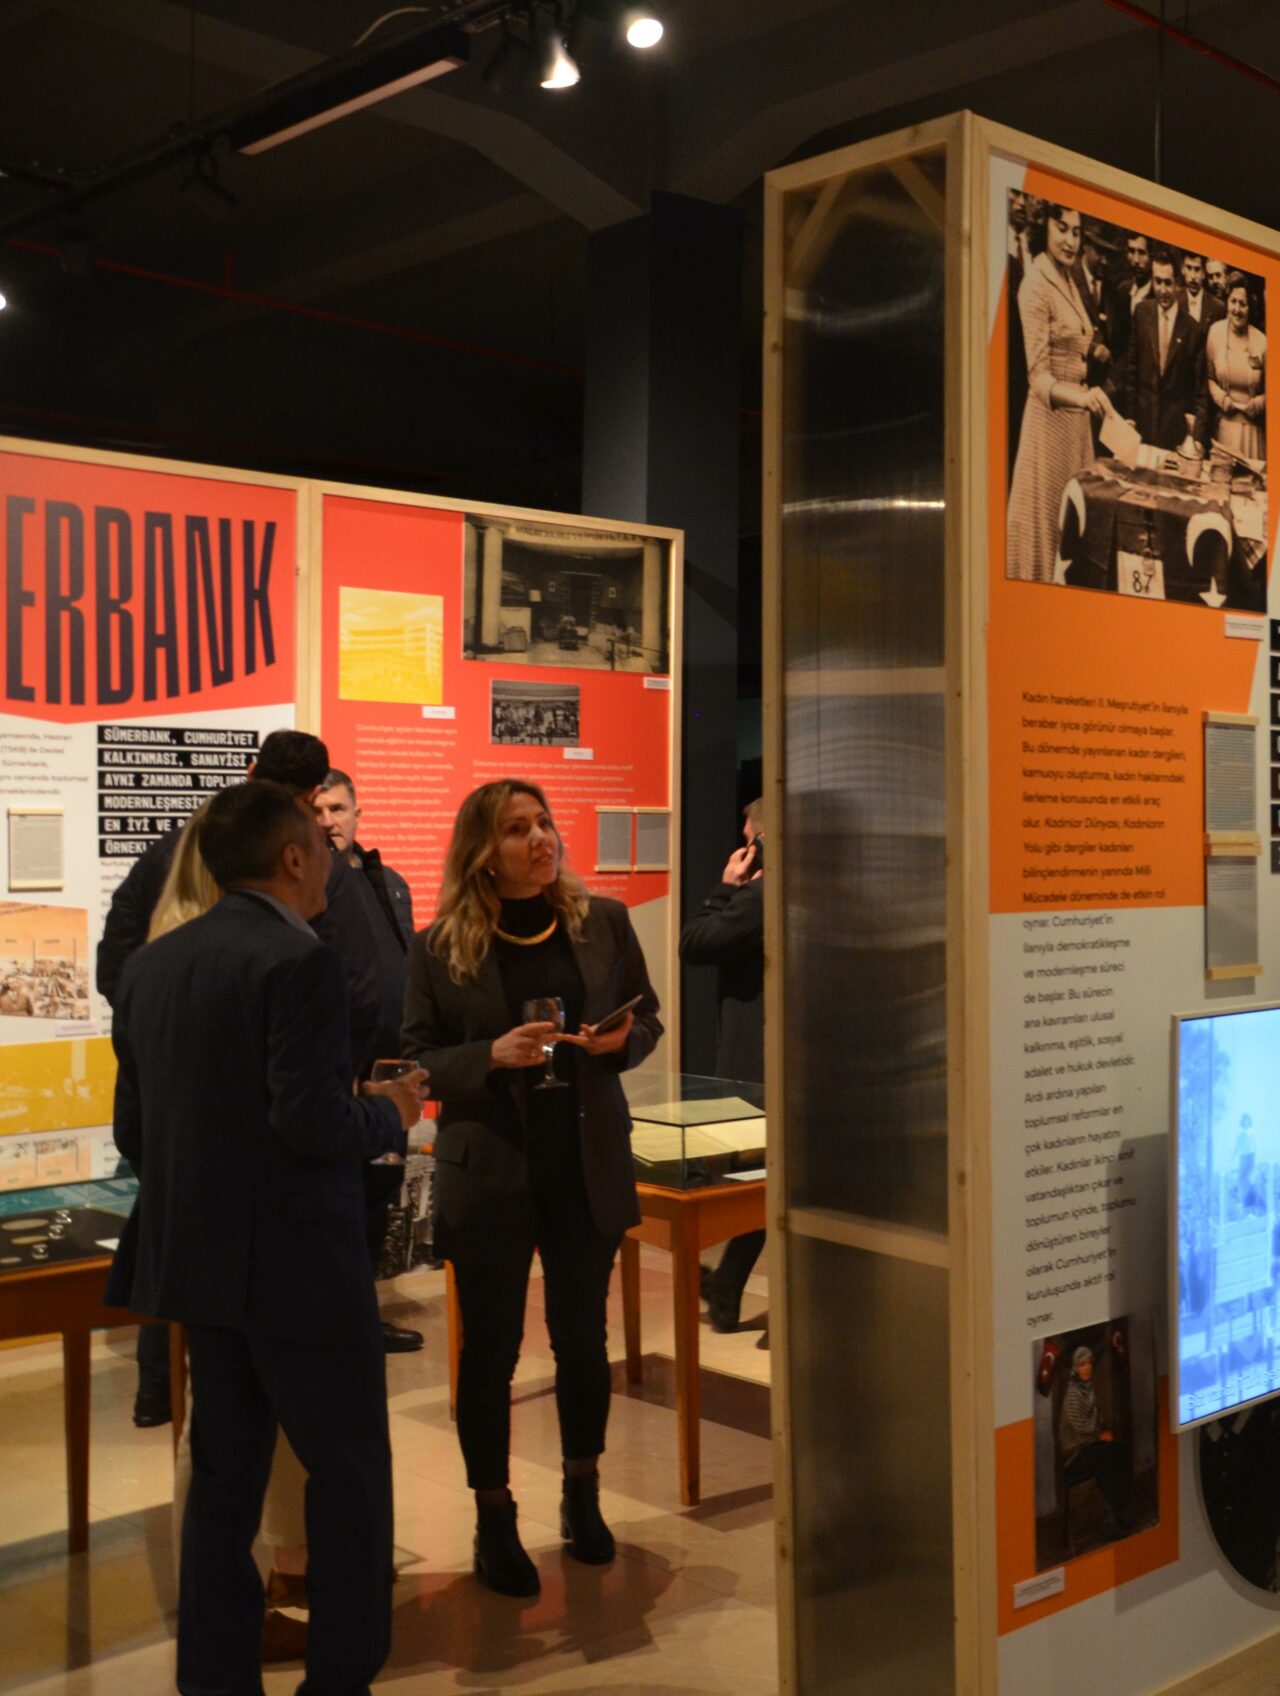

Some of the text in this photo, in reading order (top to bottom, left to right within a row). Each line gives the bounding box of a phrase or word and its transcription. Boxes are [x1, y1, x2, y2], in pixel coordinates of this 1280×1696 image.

[6, 495, 276, 705] ERBANK
[1022, 692, 1048, 702] Kadın
[1022, 717, 1057, 728] beraber
[1060, 719, 1080, 732] iyice
[1083, 720, 1115, 733] görünür
[1119, 724, 1147, 737] olmaya
[104, 728, 254, 745] SÜMERBANK, CUMHURİYET
[1022, 742, 1034, 752] Bu
[1038, 742, 1079, 754] dönemde
[1129, 747, 1150, 758] kadın
[104, 753, 184, 767] KALKINMASI,
[191, 753, 247, 767] SANAYİSİ
[104, 774, 136, 786] AYNI
[142, 775, 193, 788] ZAMANDA
[1023, 770, 1063, 780] kamuoyu
[1067, 769, 1111, 782] oluşturma,
[1114, 770, 1135, 780] kadın
[1023, 793, 1058, 803] ilerleme
[1061, 793, 1107, 804] konusunda
[1111, 796, 1120, 804] en
[105, 819, 120, 831] EN
[127, 817, 150, 831] İYİ
[156, 819, 171, 831] VE
[1045, 818, 1082, 828] Kadınlar
[1045, 843, 1061, 855] gibi
[1064, 843, 1097, 855] dergiler
[1101, 867, 1133, 879] yanında
[1023, 892, 1066, 903] Mücadele
[1070, 890, 1118, 902] döneminde
[1121, 890, 1130, 899] de
[1052, 914, 1113, 929] Cumhuriyet'in
[1023, 938, 1130, 955] ilanıyla demokratikleşme
[1024, 962, 1125, 978] ve modernleşme süreci
[1024, 993, 1036, 1004] de
[1068, 989, 1080, 1000] Bu
[1083, 986, 1113, 999] sürecin
[1024, 1020, 1040, 1029] ana
[1091, 1011, 1114, 1022] ulusal
[1097, 1033, 1123, 1047] sosyal
[1025, 1066, 1052, 1079] adalet
[1055, 1065, 1065, 1074] ve
[1067, 1060, 1093, 1073] hukuk
[1025, 1113, 1069, 1129] toplumsal
